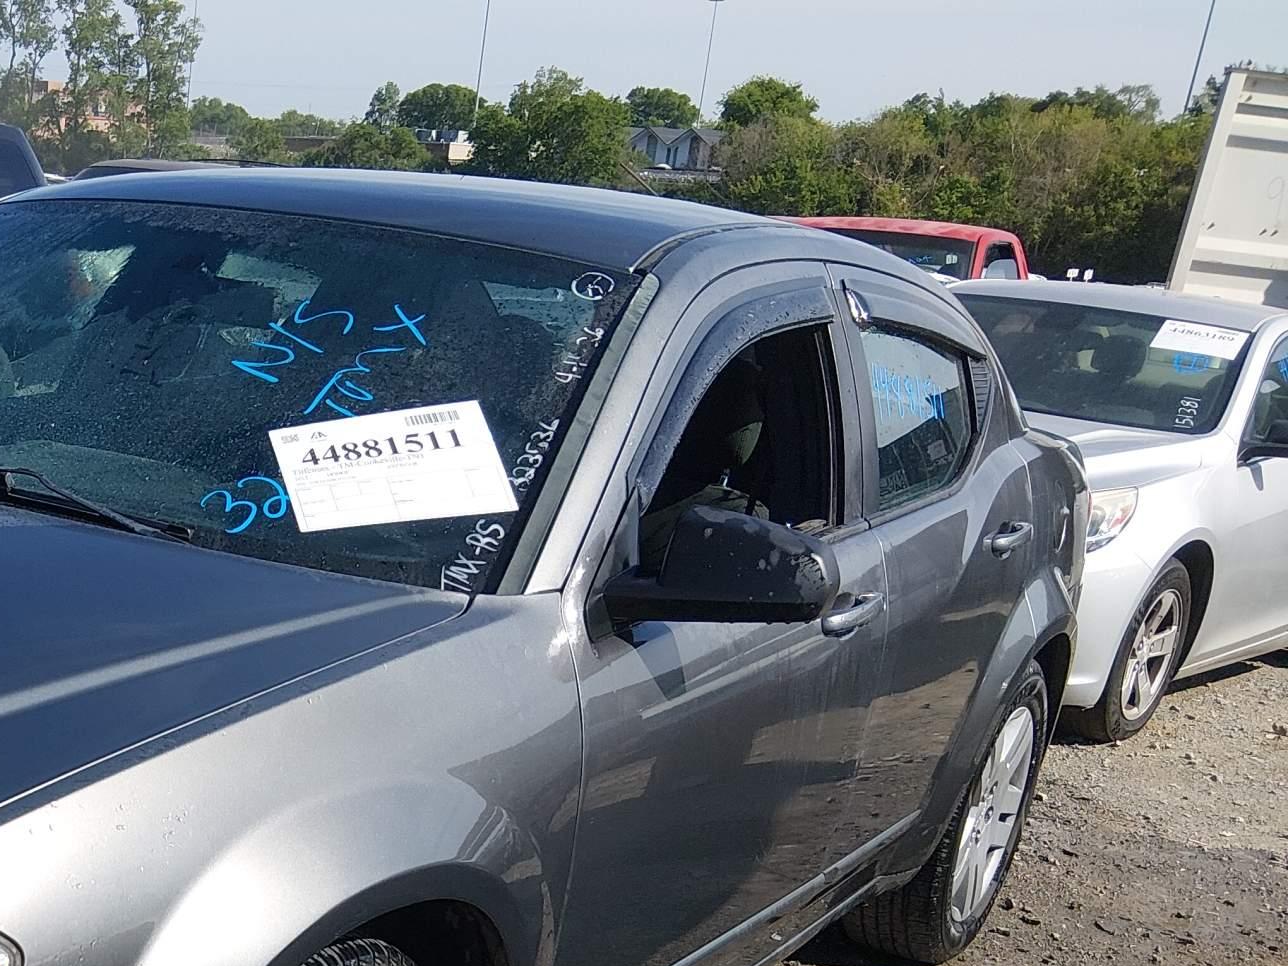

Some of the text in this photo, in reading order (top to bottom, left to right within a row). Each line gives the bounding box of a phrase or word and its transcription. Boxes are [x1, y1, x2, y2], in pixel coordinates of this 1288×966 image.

[1172, 396, 1202, 429] 151381
[302, 428, 463, 466] 44881511
[441, 519, 506, 592] TMX-RS
